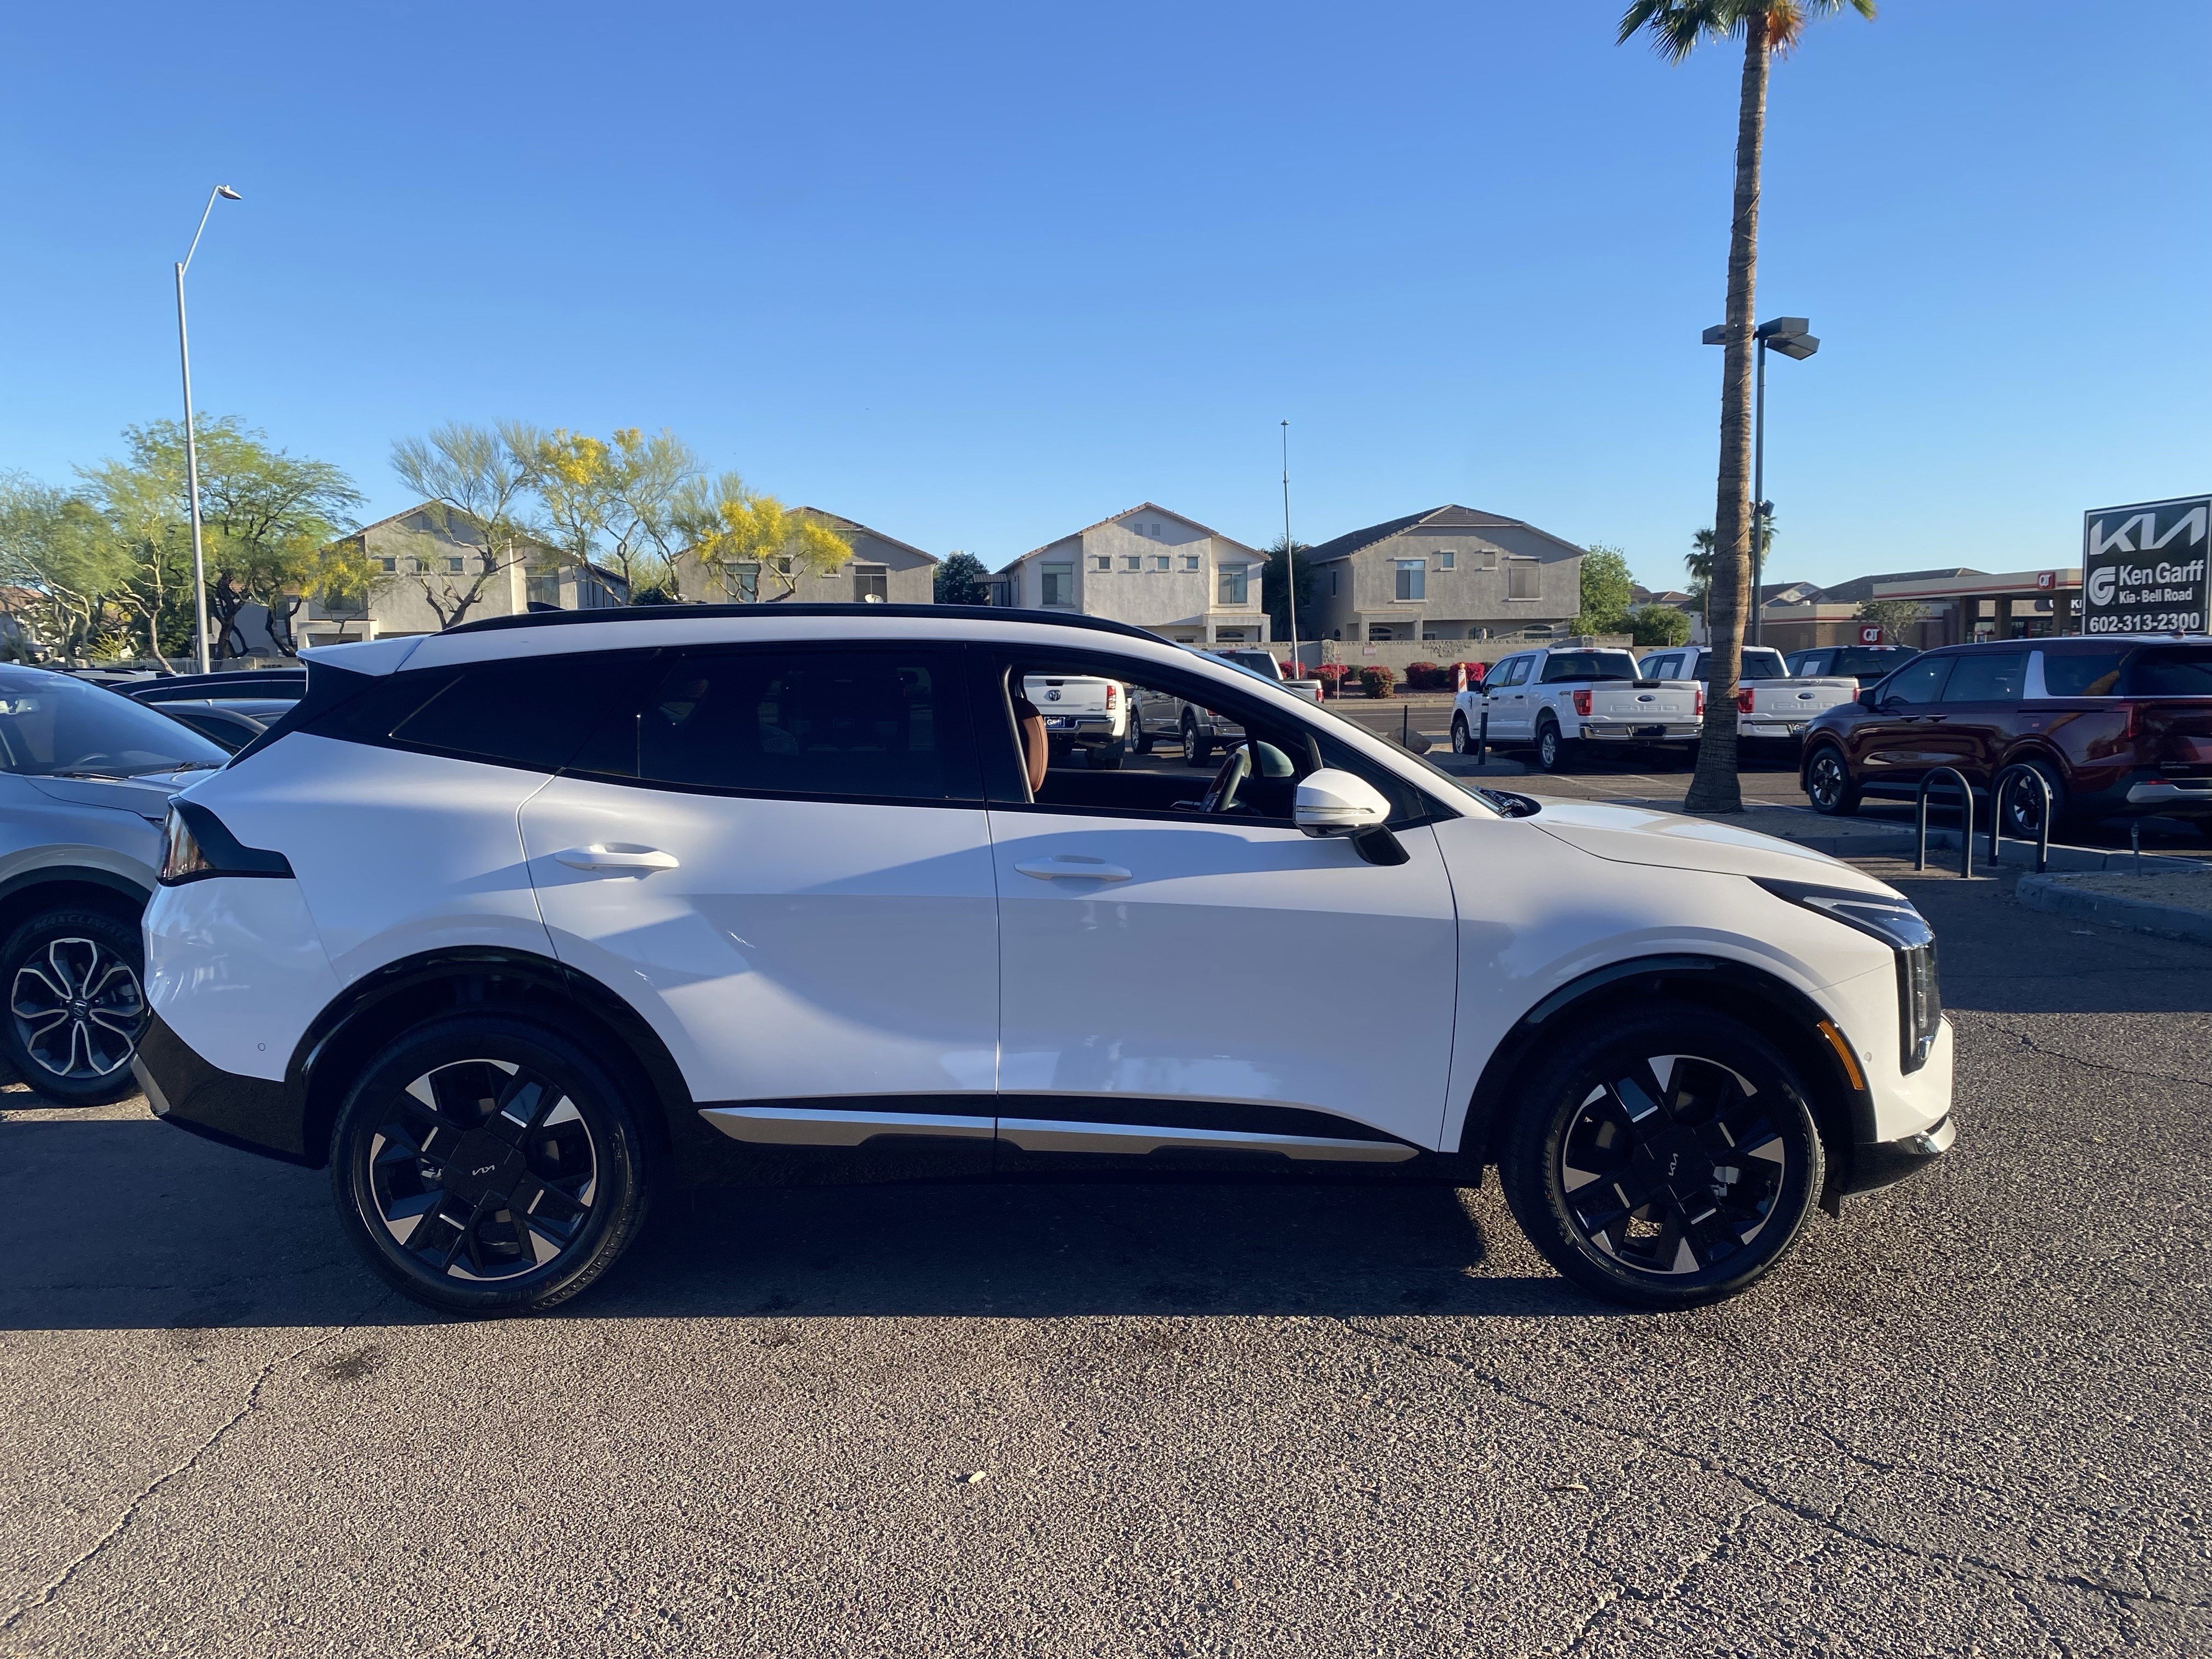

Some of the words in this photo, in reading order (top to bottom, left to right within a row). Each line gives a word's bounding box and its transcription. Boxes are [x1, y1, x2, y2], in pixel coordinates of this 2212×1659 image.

[2089, 506, 2207, 555] KIA
[2039, 574, 2051, 587] QT
[2119, 565, 2153, 586] Ken
[2155, 559, 2204, 584] Garff
[2164, 587, 2193, 602] Road
[2089, 612, 2200, 633] 602-313-2300
[1863, 628, 1880, 642] QT
